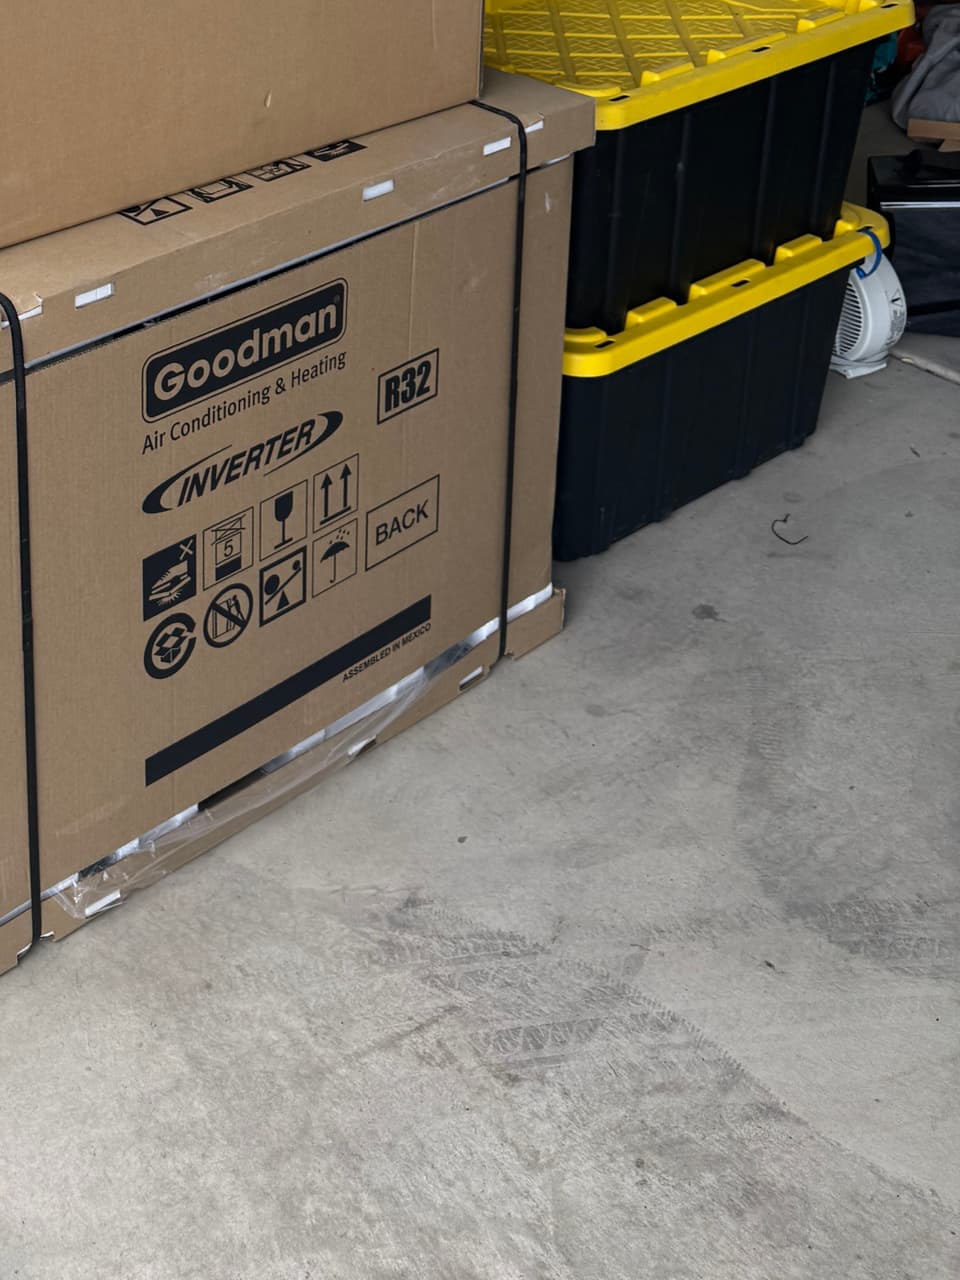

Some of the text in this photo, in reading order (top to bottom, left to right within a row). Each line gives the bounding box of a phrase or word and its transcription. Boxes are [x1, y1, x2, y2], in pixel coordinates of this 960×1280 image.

[153, 302, 338, 401] Goodman
[142, 350, 347, 455] Air Conditioning & Heating
[384, 360, 431, 413] R32
[177, 418, 316, 508] INVERTER
[223, 538, 235, 558] 5
[375, 498, 429, 547] BACK
[342, 622, 432, 683] ASSEMBLED IN MEXICO
